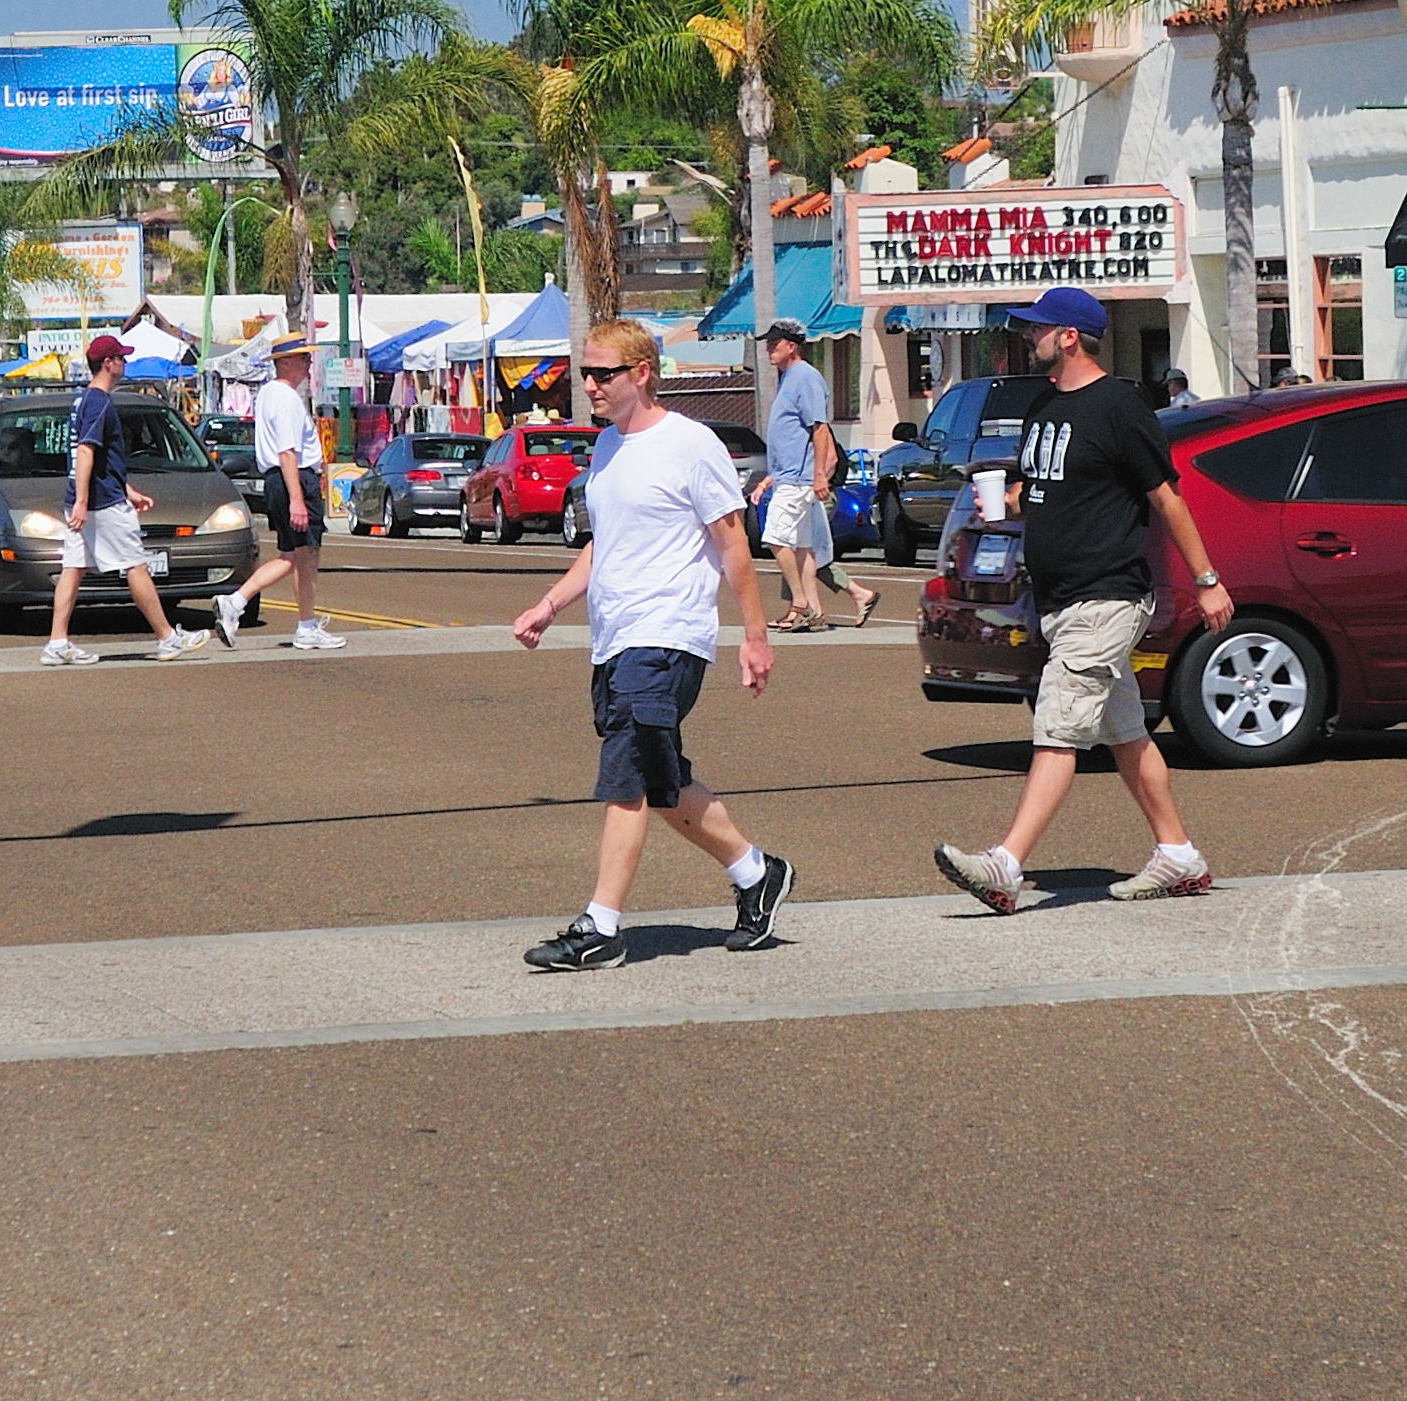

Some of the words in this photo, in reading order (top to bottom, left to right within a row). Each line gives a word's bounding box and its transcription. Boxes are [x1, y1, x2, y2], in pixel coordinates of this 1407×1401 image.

[3, 85, 50, 108] Love
[56, 85, 75, 106] at
[81, 83, 124, 106] first
[128, 82, 164, 110] sip.
[225, 106, 251, 124] GIRL
[886, 208, 993, 234] MAMMA
[999, 206, 1048, 231] MIA
[92, 232, 135, 242] Garden
[918, 233, 993, 260] DARK
[1010, 229, 1112, 256] KNIGHT
[1119, 230, 1164, 251] 820
[1397, 269, 1405, 281] 2
[38, 332, 70, 343] PATIO
